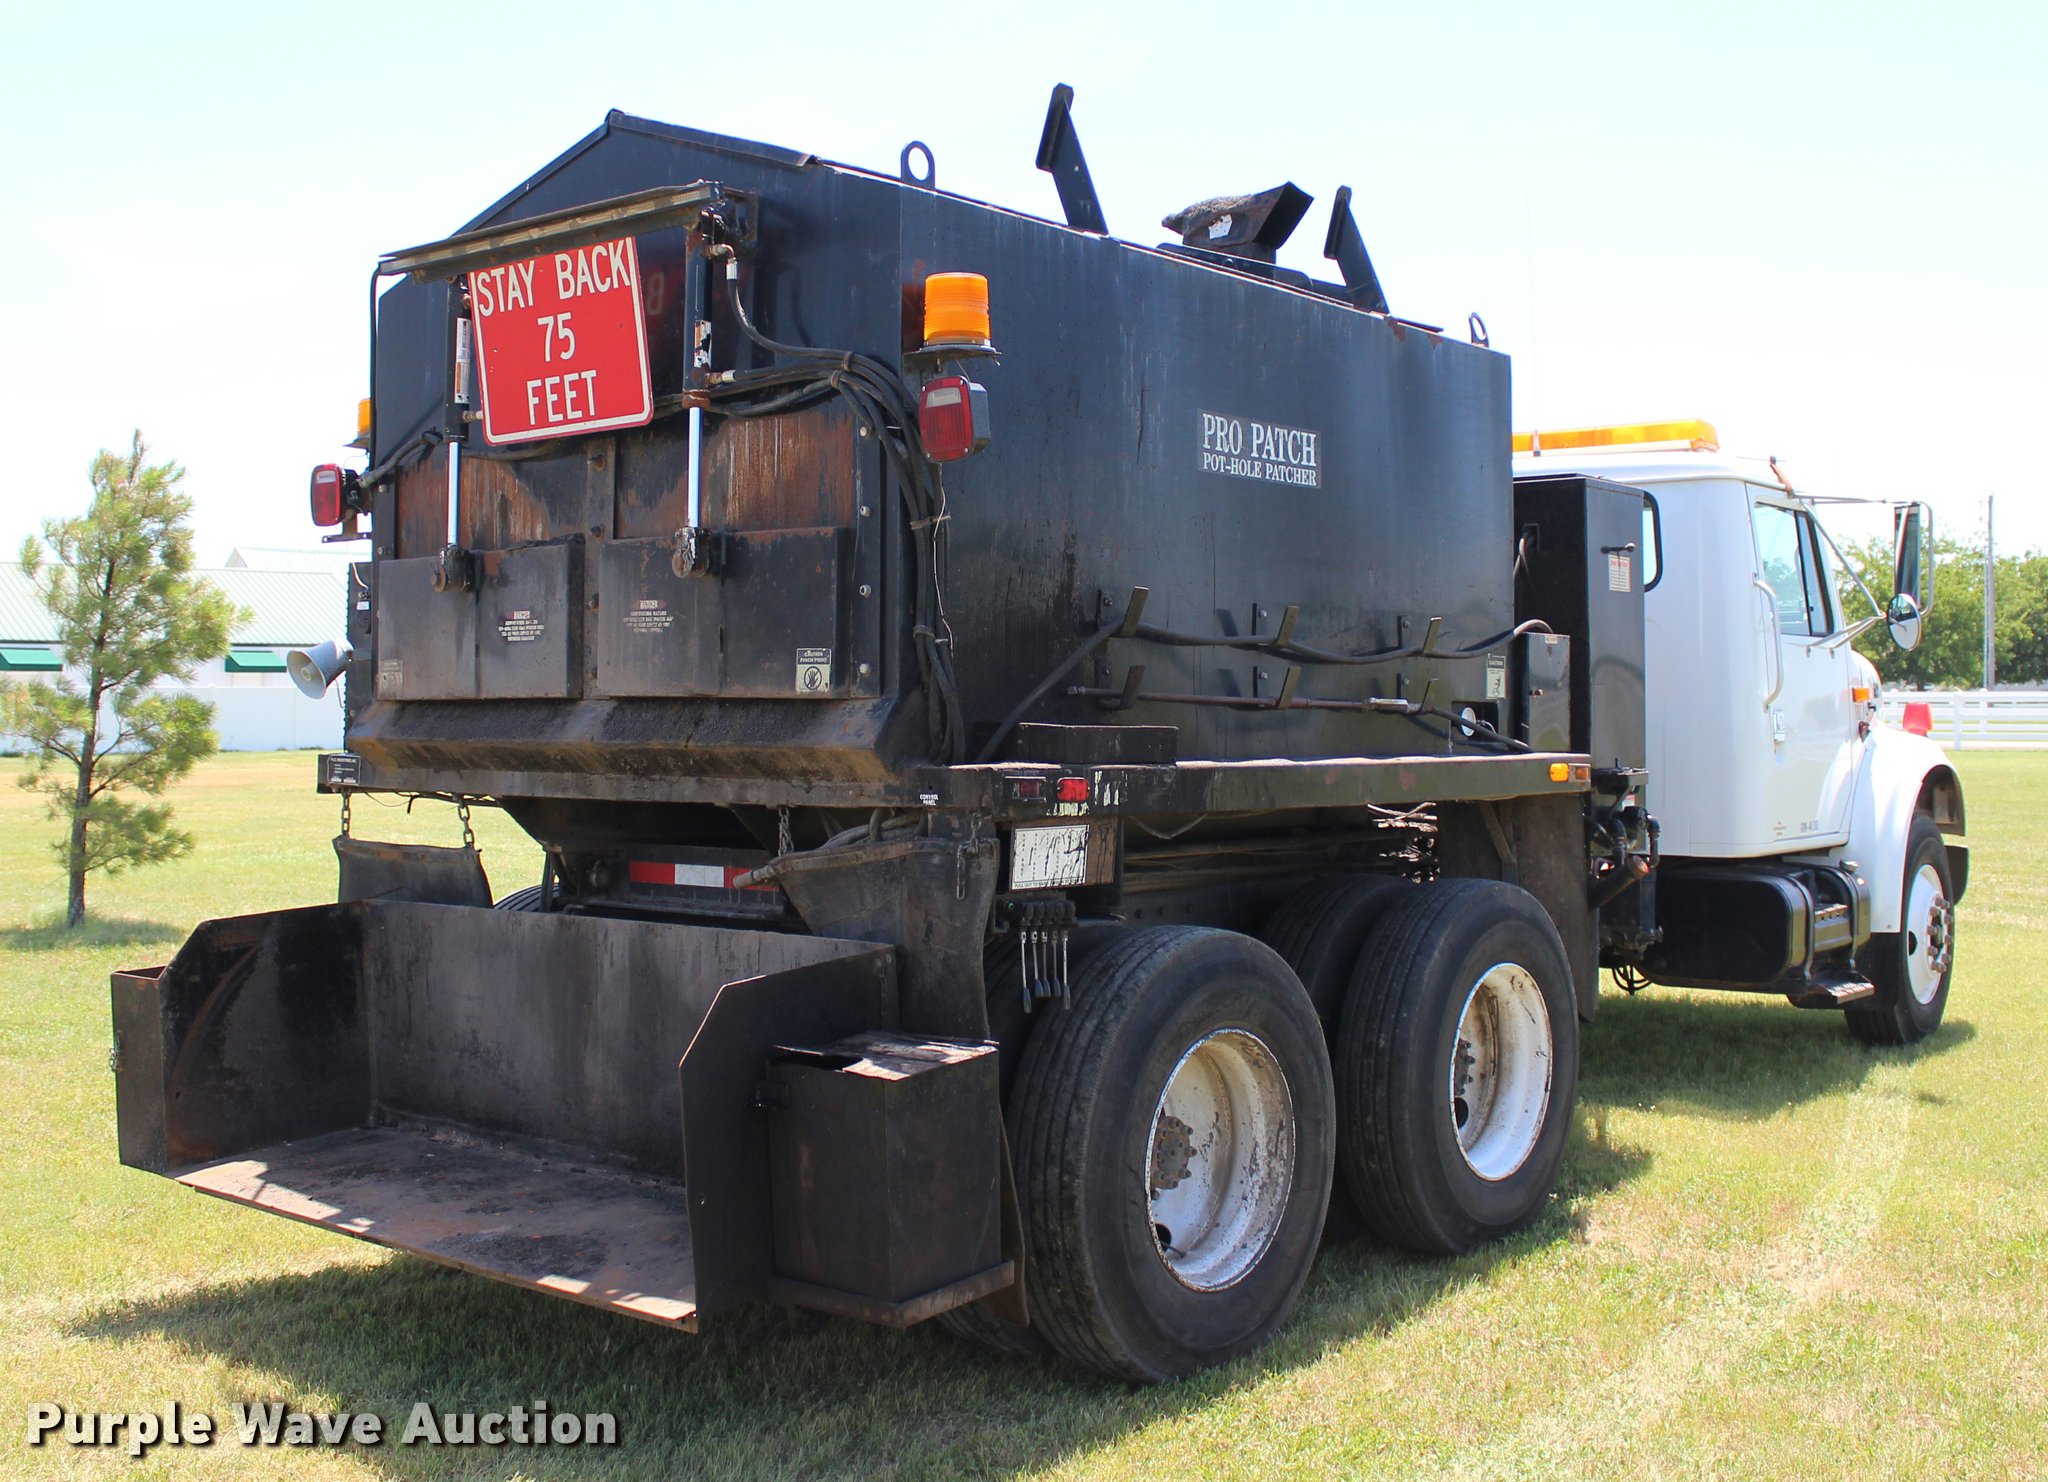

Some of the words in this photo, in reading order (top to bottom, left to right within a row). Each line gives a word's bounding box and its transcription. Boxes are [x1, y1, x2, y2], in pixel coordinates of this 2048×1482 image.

[477, 260, 535, 317] STAY
[554, 240, 631, 300] BACK
[537, 311, 576, 362] 75
[526, 369, 597, 426] FEET
[1202, 413, 1243, 456] PRO
[1250, 422, 1317, 467] PATCH
[1203, 452, 1262, 479] POT-HOLE
[1265, 462, 1317, 487] PATCHER
